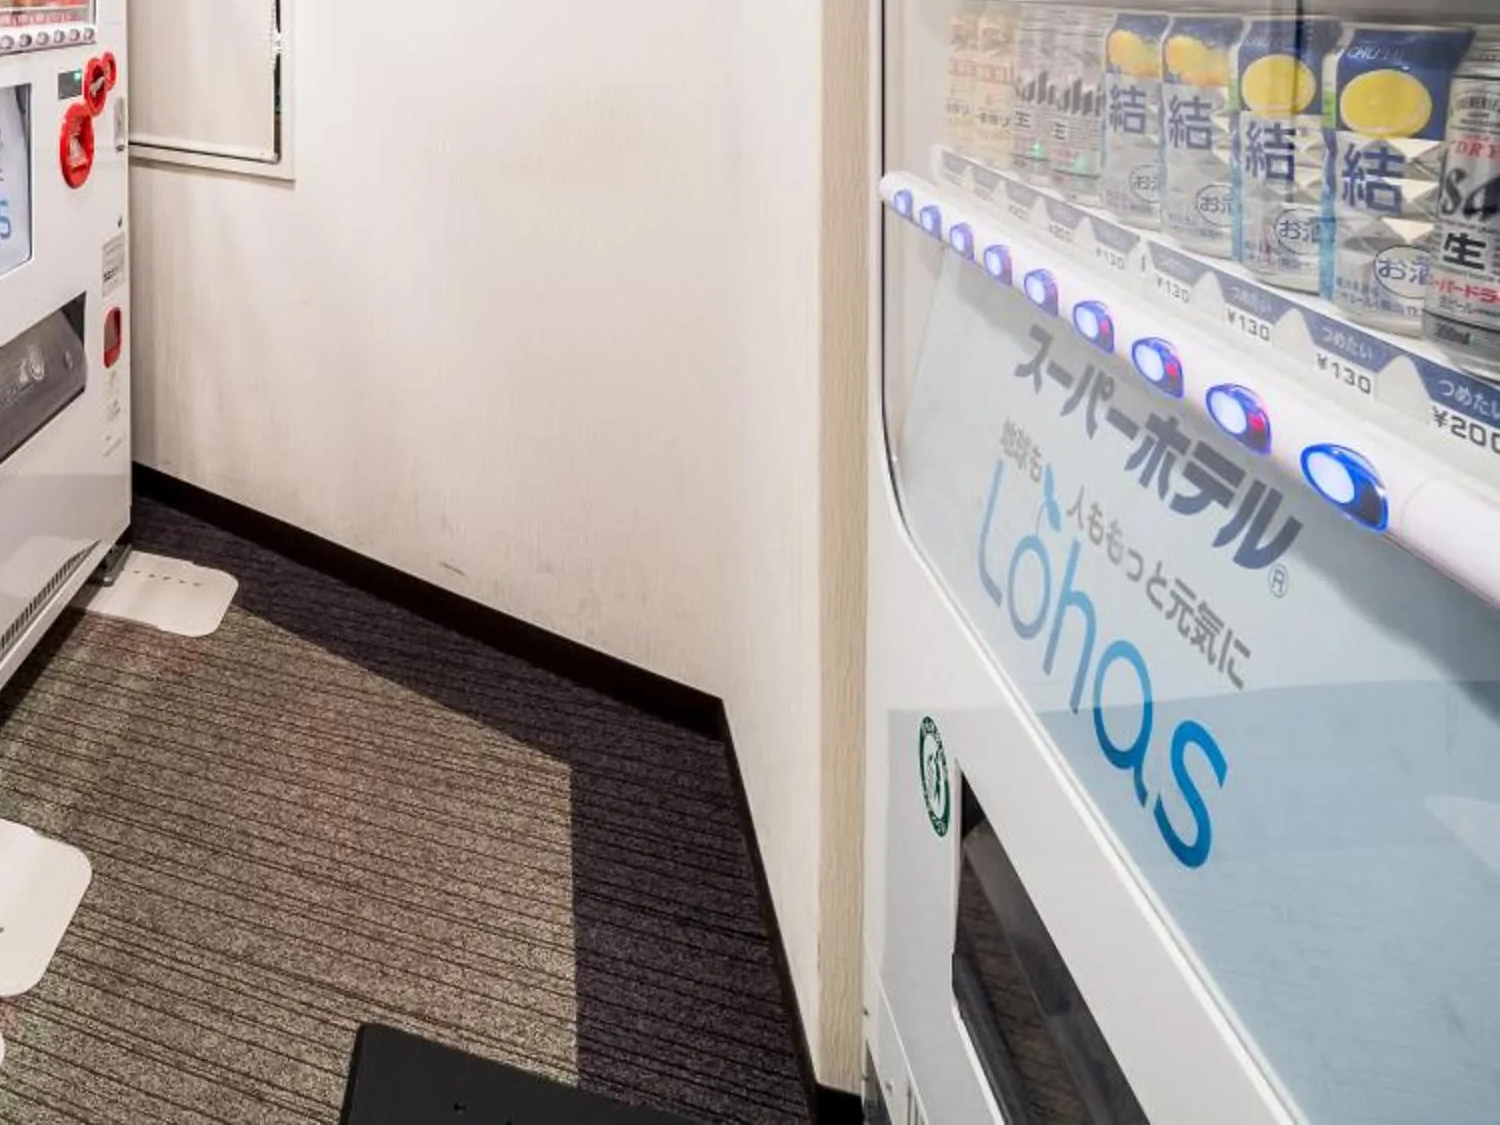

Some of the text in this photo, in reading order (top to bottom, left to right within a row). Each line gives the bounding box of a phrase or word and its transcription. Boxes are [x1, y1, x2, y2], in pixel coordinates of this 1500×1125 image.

[1443, 232, 1487, 270] 生
[1226, 307, 1270, 342] ¥130
[1316, 353, 1372, 395] ¥130
[1000, 414, 1043, 484] 地球も
[1014, 323, 1303, 570] スーパーホテル
[1065, 484, 1252, 691] 人ももっと元気に
[976, 459, 1228, 870] Lohas
